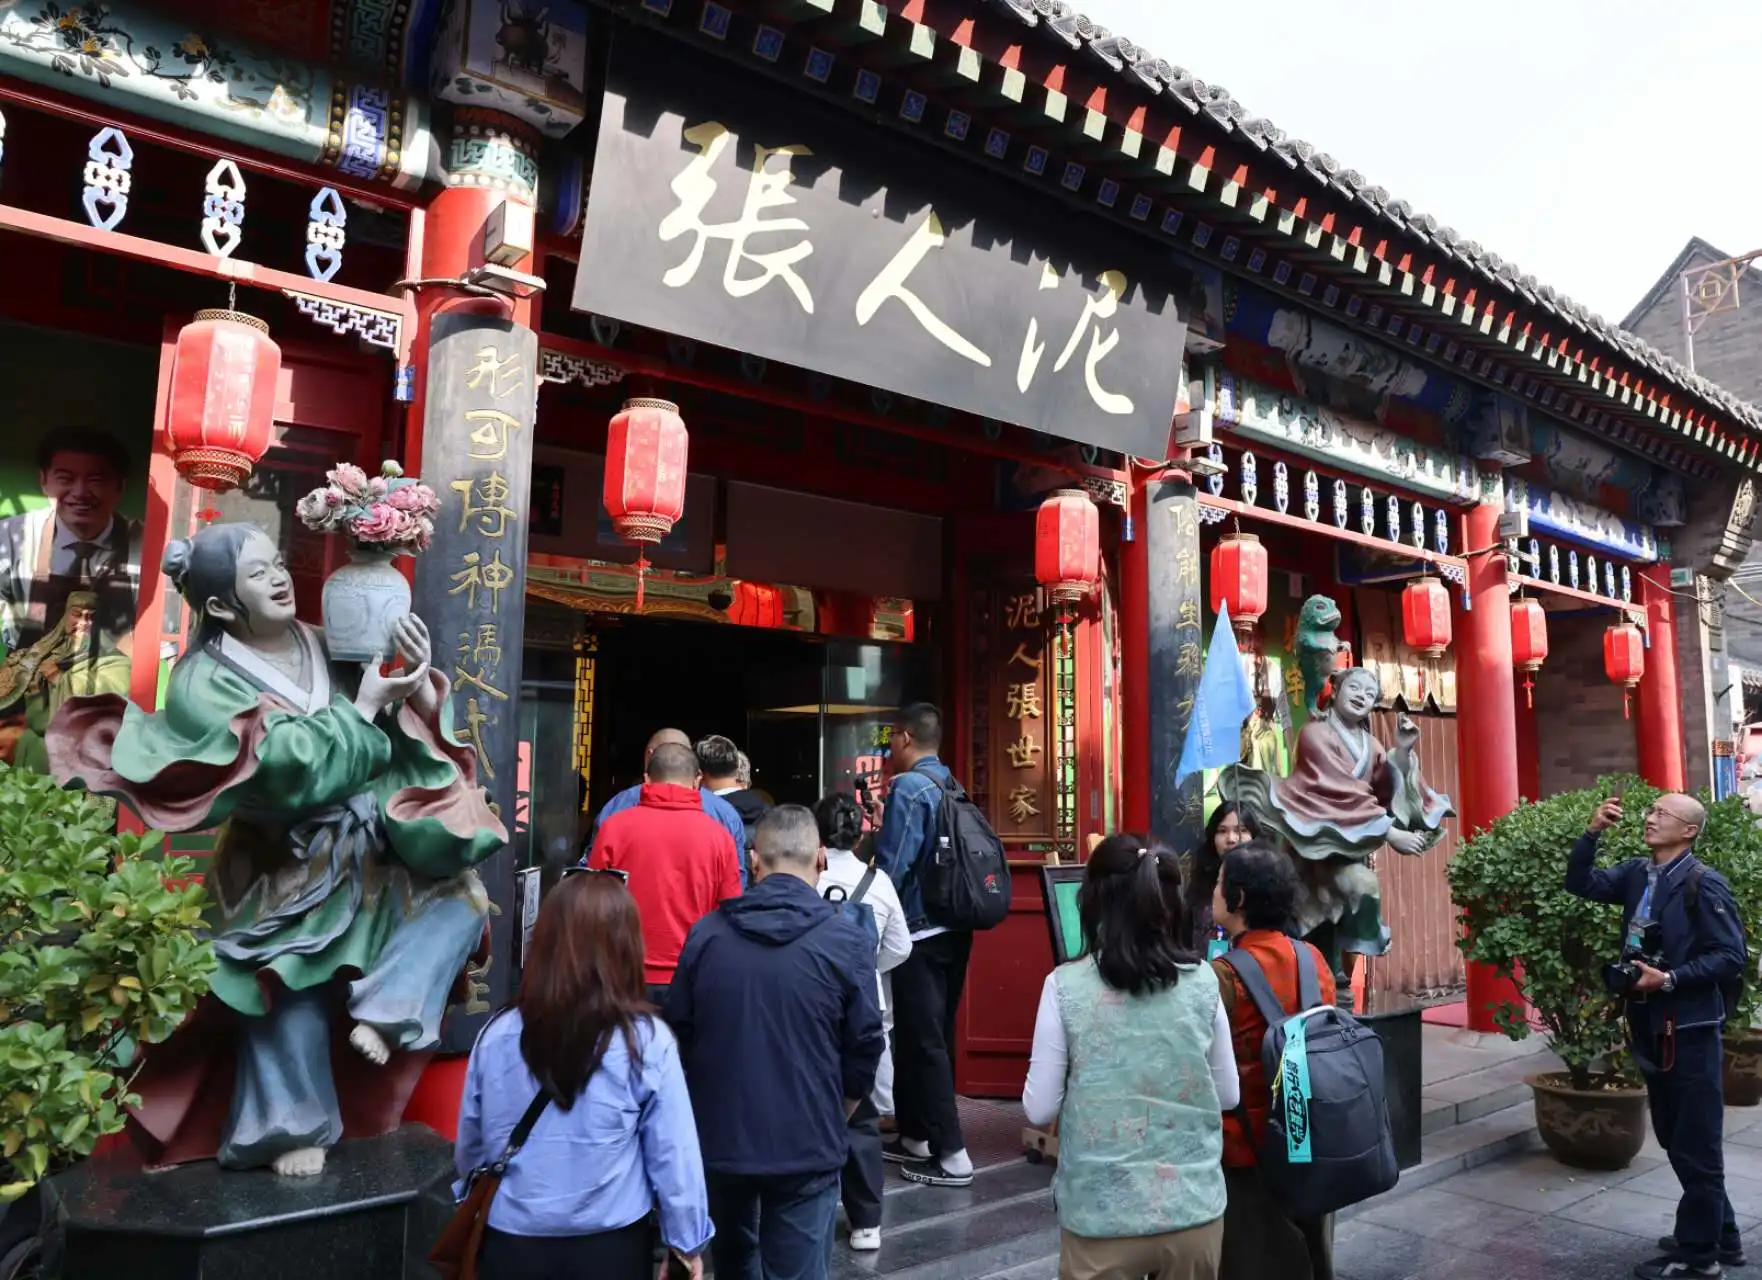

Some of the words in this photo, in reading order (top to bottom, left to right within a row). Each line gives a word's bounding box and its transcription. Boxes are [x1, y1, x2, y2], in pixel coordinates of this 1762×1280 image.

[1005, 594, 1043, 823] 泥人張世家
